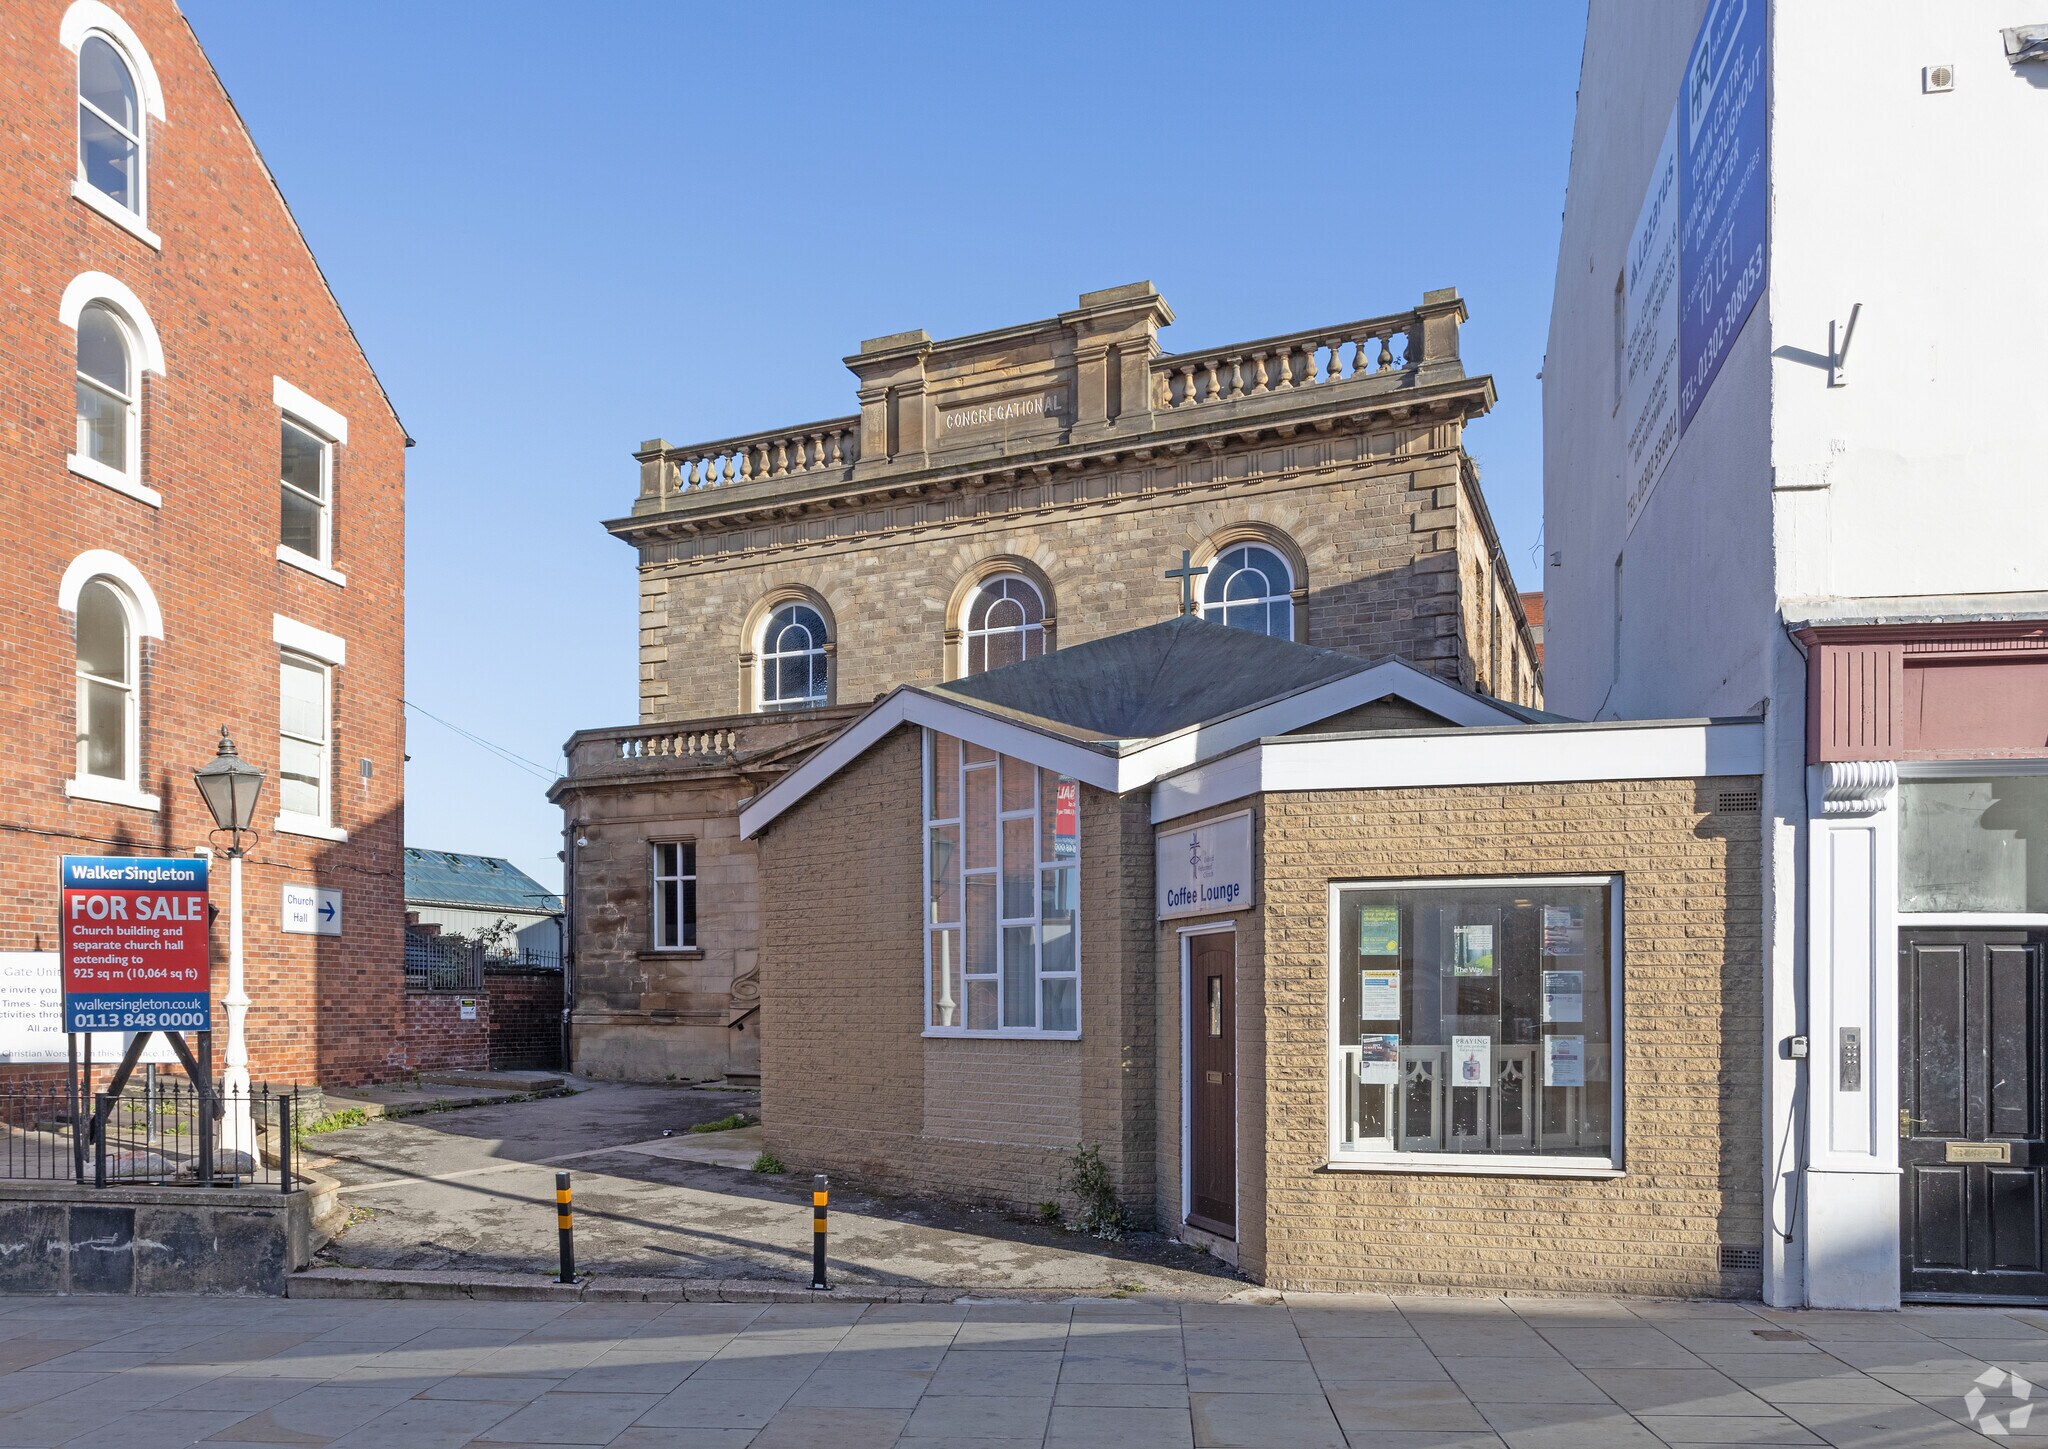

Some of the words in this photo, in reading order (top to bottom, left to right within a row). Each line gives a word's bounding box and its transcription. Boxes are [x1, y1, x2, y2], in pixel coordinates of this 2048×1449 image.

[1692, 122, 1712, 190] TOWN
[1714, 43, 1744, 134] CENTRE
[1682, 185, 1702, 252] LIVING
[1704, 45, 1761, 197] THROUGHOUT
[1727, 146, 1759, 227] properties
[1696, 136, 1739, 252] DONCASTER
[1638, 152, 1673, 272] Lazarus
[1699, 272, 1713, 326] TO
[1716, 221, 1734, 294] LET
[1681, 373, 1697, 418] TEL:
[1698, 316, 1724, 387] 01302
[1726, 242, 1762, 336] 308053
[946, 394, 1062, 430] CONGREGATIONAL
[287, 894, 314, 906] Church
[1167, 886, 1198, 907] Coffee
[1200, 882, 1240, 902] Lounge
[71, 895, 128, 920] FOR
[135, 895, 202, 921] SALE
[293, 912, 308, 923] Hall
[72, 925, 113, 936] Church
[117, 925, 160, 938] building
[163, 926, 183, 936] and
[73, 942, 121, 953] separate
[124, 940, 162, 950] church
[165, 940, 184, 950] hall
[73, 954, 128, 967] extending
[131, 956, 143, 964] to
[4, 966, 32, 976] Gate
[73, 968, 94, 978] 925
[97, 971, 110, 980] sq
[126, 968, 168, 980] (10,064
[170, 971, 182, 980] sq
[185, 967, 198, 980] ft)
[1468, 966, 1484, 974] Way
[9, 985, 37, 994] invite
[2, 999, 31, 1007] Times
[74, 997, 201, 1013] walkersingleton.co.uk
[74, 1013, 119, 1027] 0113
[123, 1013, 157, 1027] 848
[159, 1012, 204, 1027] 0000
[27, 1024, 40, 1032] All
[2, 1049, 42, 1057] Christian
